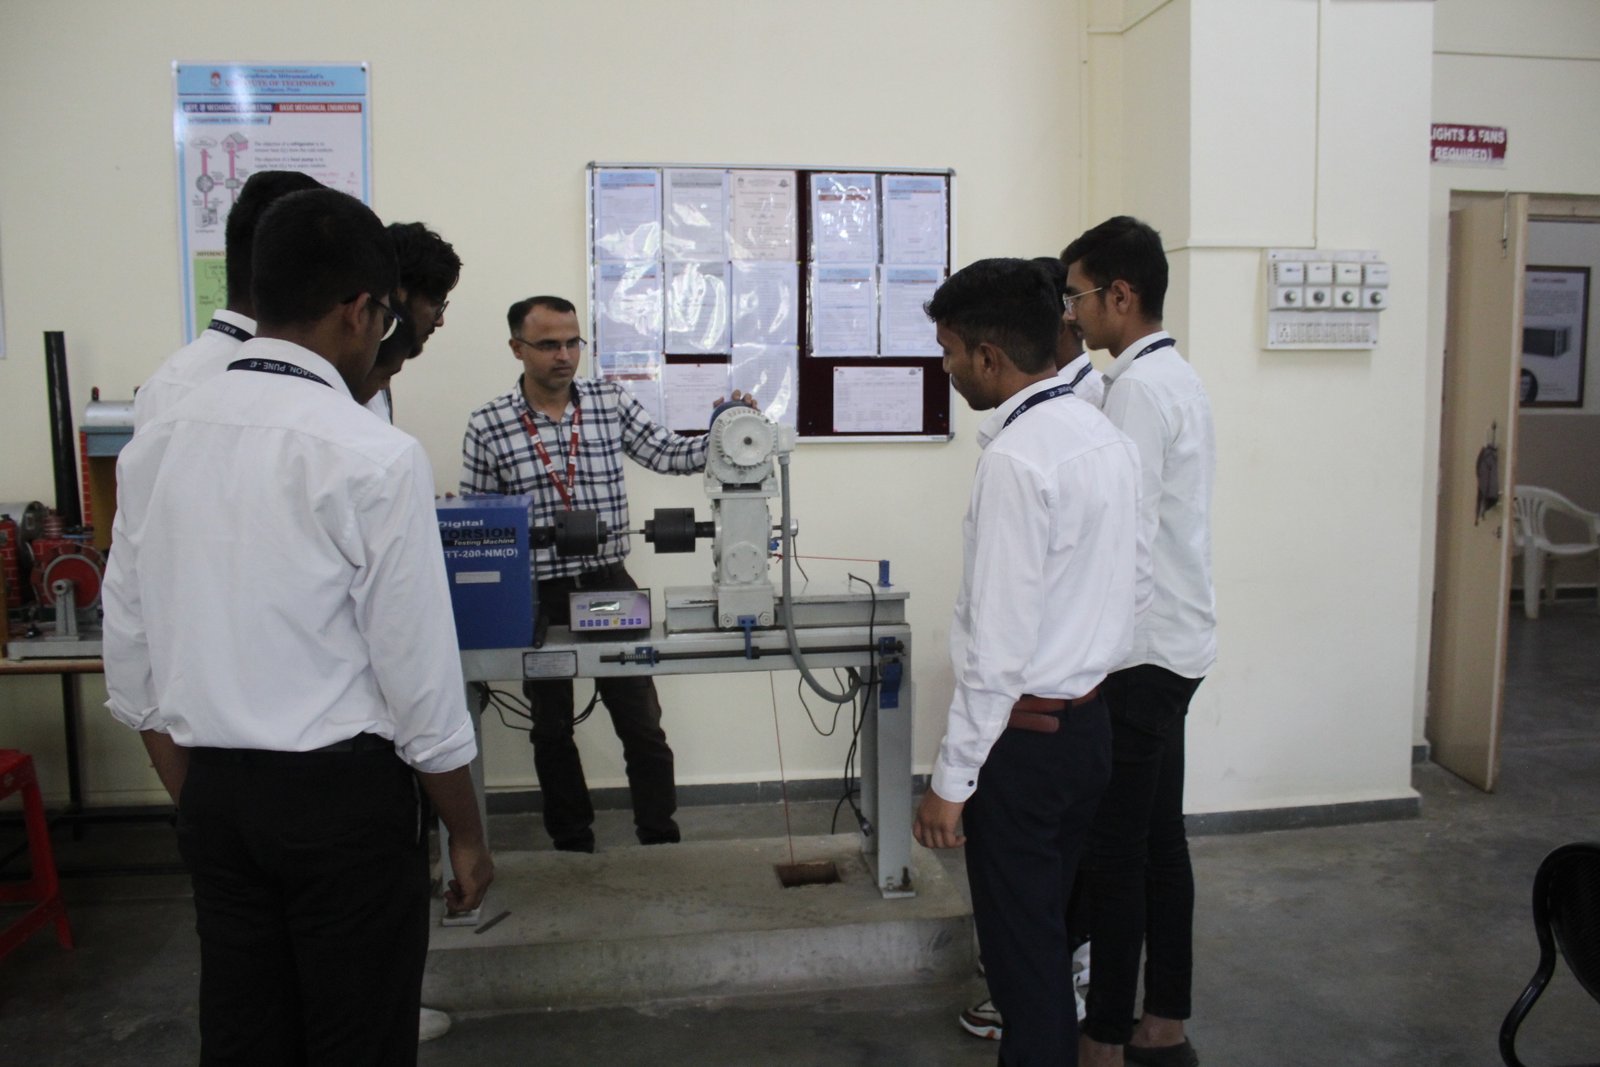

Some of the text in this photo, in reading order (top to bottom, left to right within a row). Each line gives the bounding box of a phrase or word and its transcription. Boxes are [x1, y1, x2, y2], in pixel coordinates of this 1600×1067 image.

[1431, 127, 1505, 144] IGHTS & FANS
[263, 362, 286, 372] PUNE
[438, 519, 484, 529] Digital
[440, 528, 516, 539] TORSION
